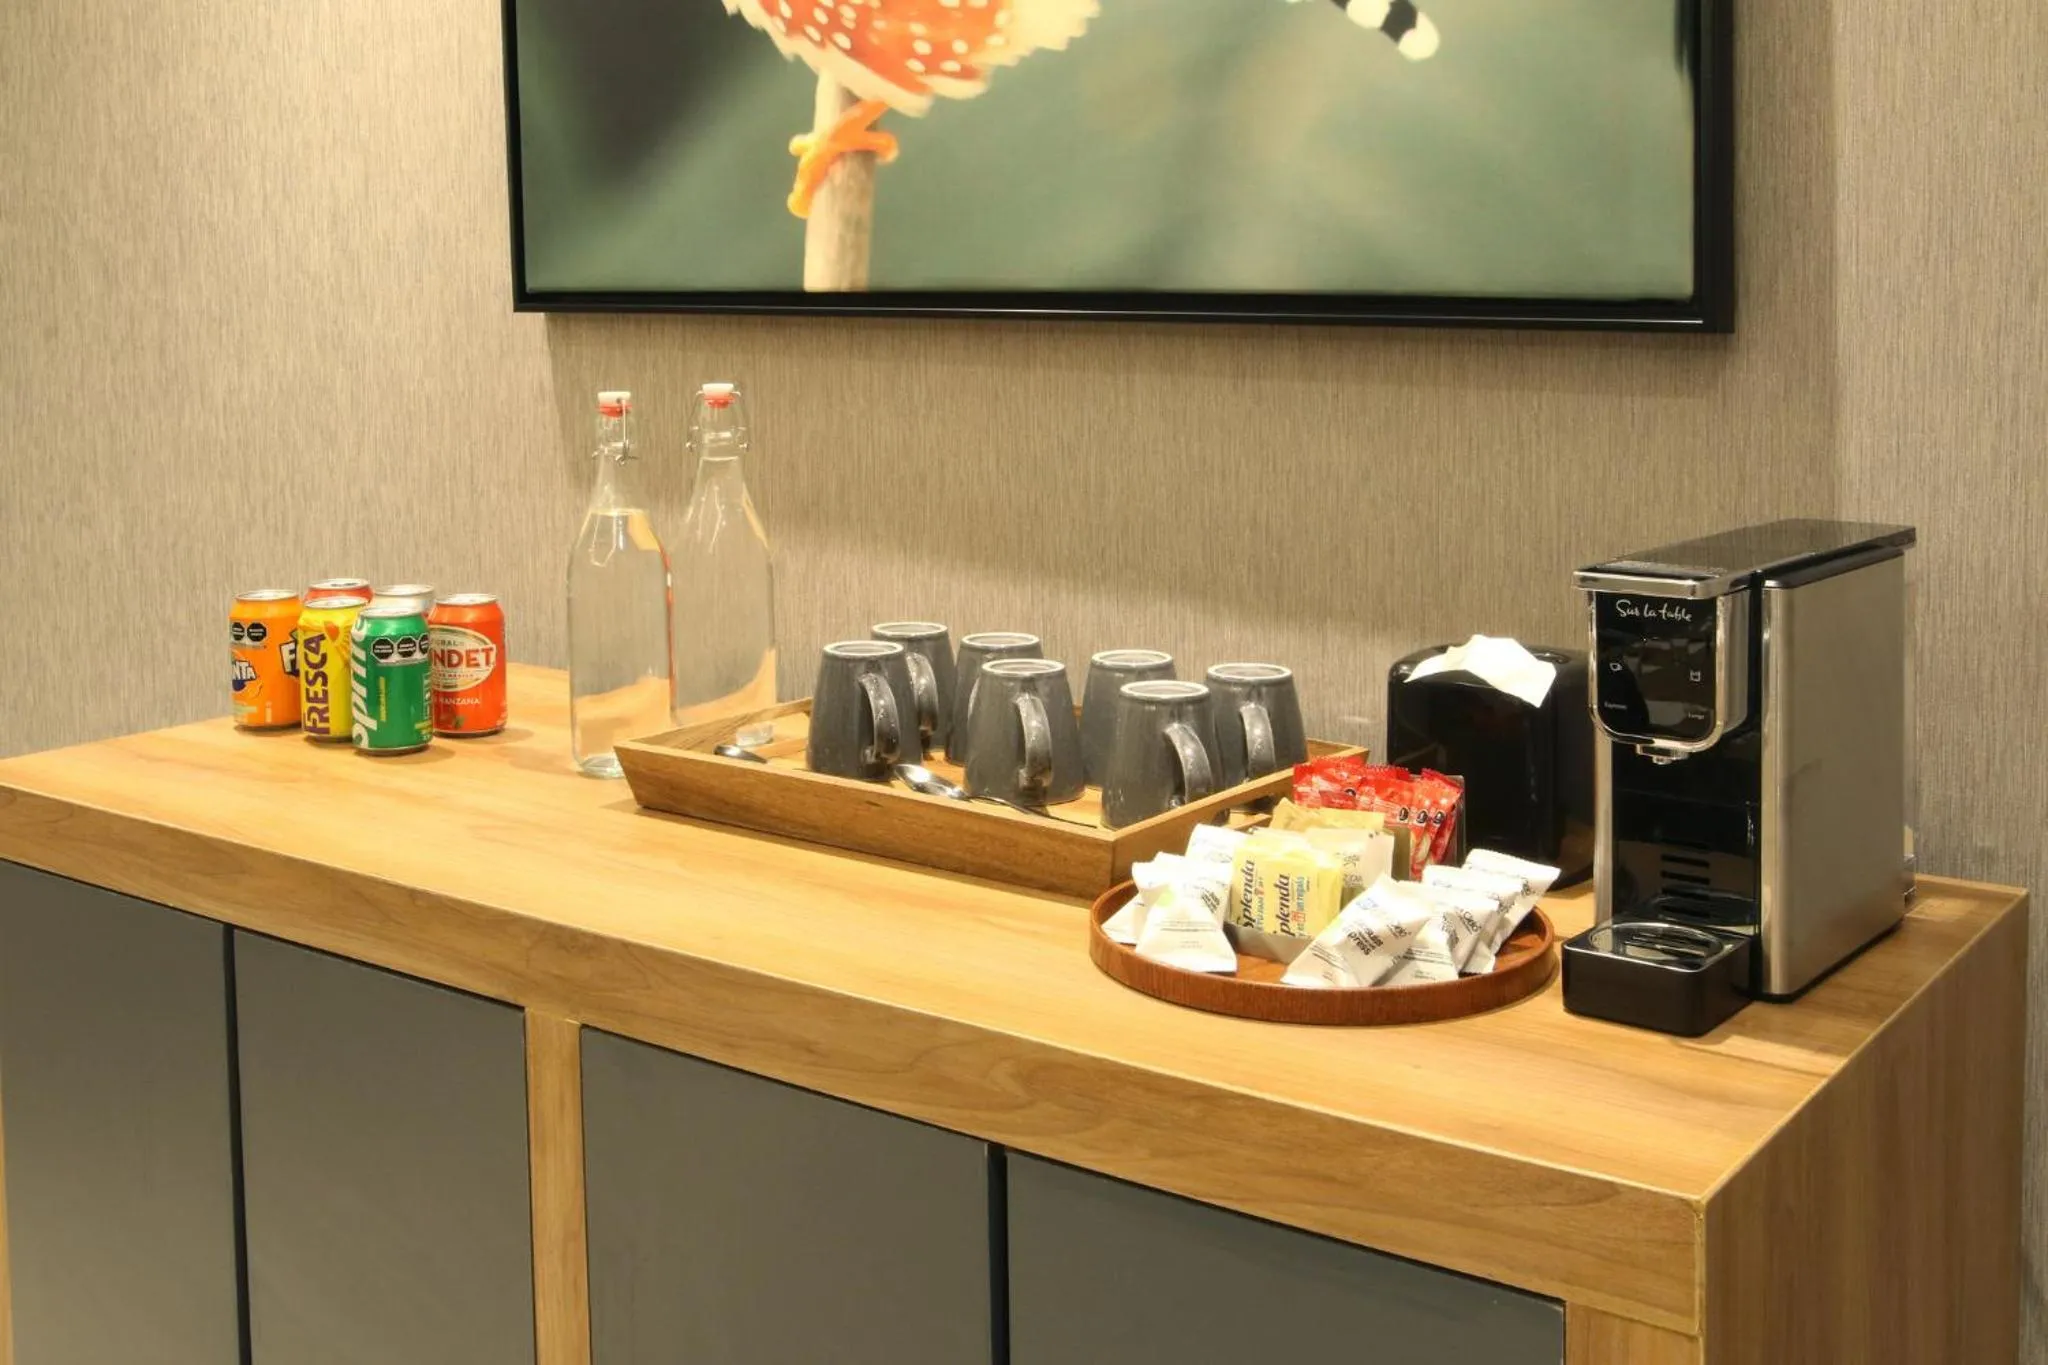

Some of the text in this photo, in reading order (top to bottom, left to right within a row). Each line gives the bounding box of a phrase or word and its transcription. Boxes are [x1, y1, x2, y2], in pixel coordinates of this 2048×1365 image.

[303, 633, 330, 735] FRESCA
[432, 646, 494, 669] NDET
[1273, 873, 1297, 937] plenda
